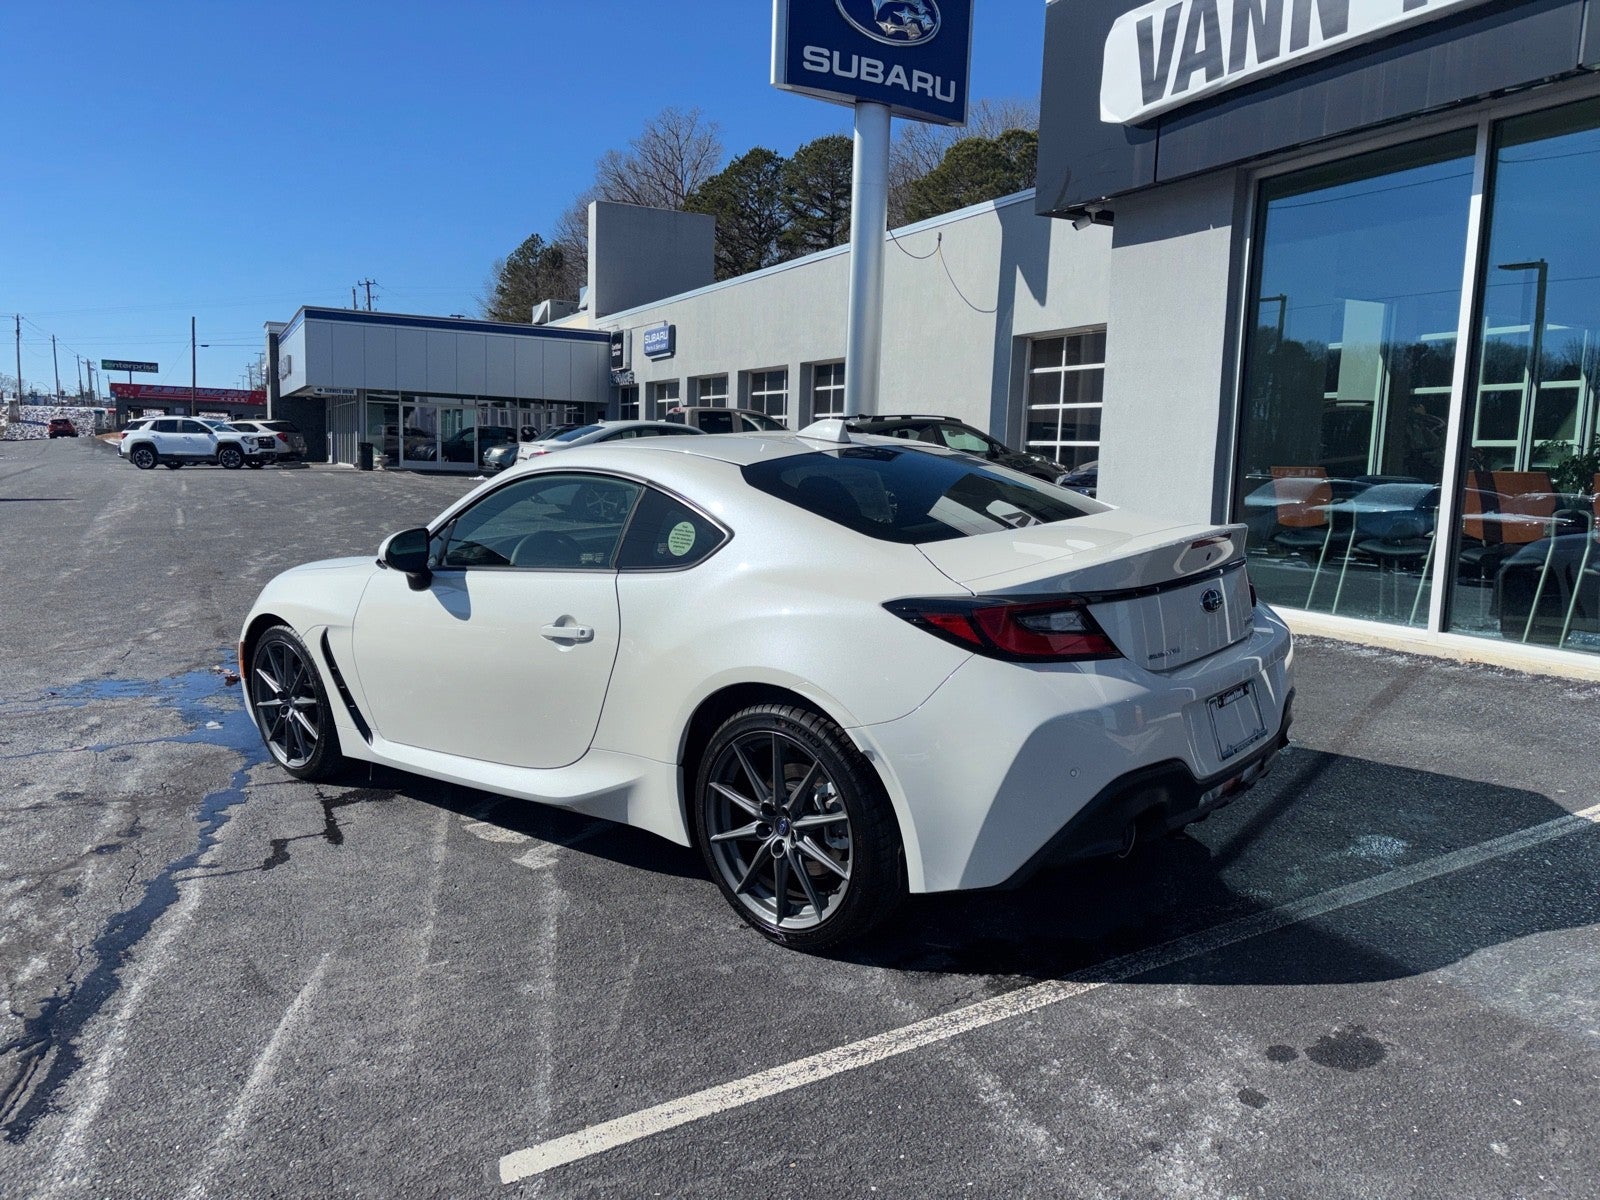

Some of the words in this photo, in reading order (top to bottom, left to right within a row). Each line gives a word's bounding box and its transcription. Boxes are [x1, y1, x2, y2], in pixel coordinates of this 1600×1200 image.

[803, 45, 956, 103] SUBARU
[644, 331, 668, 344] SUBARU
[103, 361, 158, 371] enterprise
